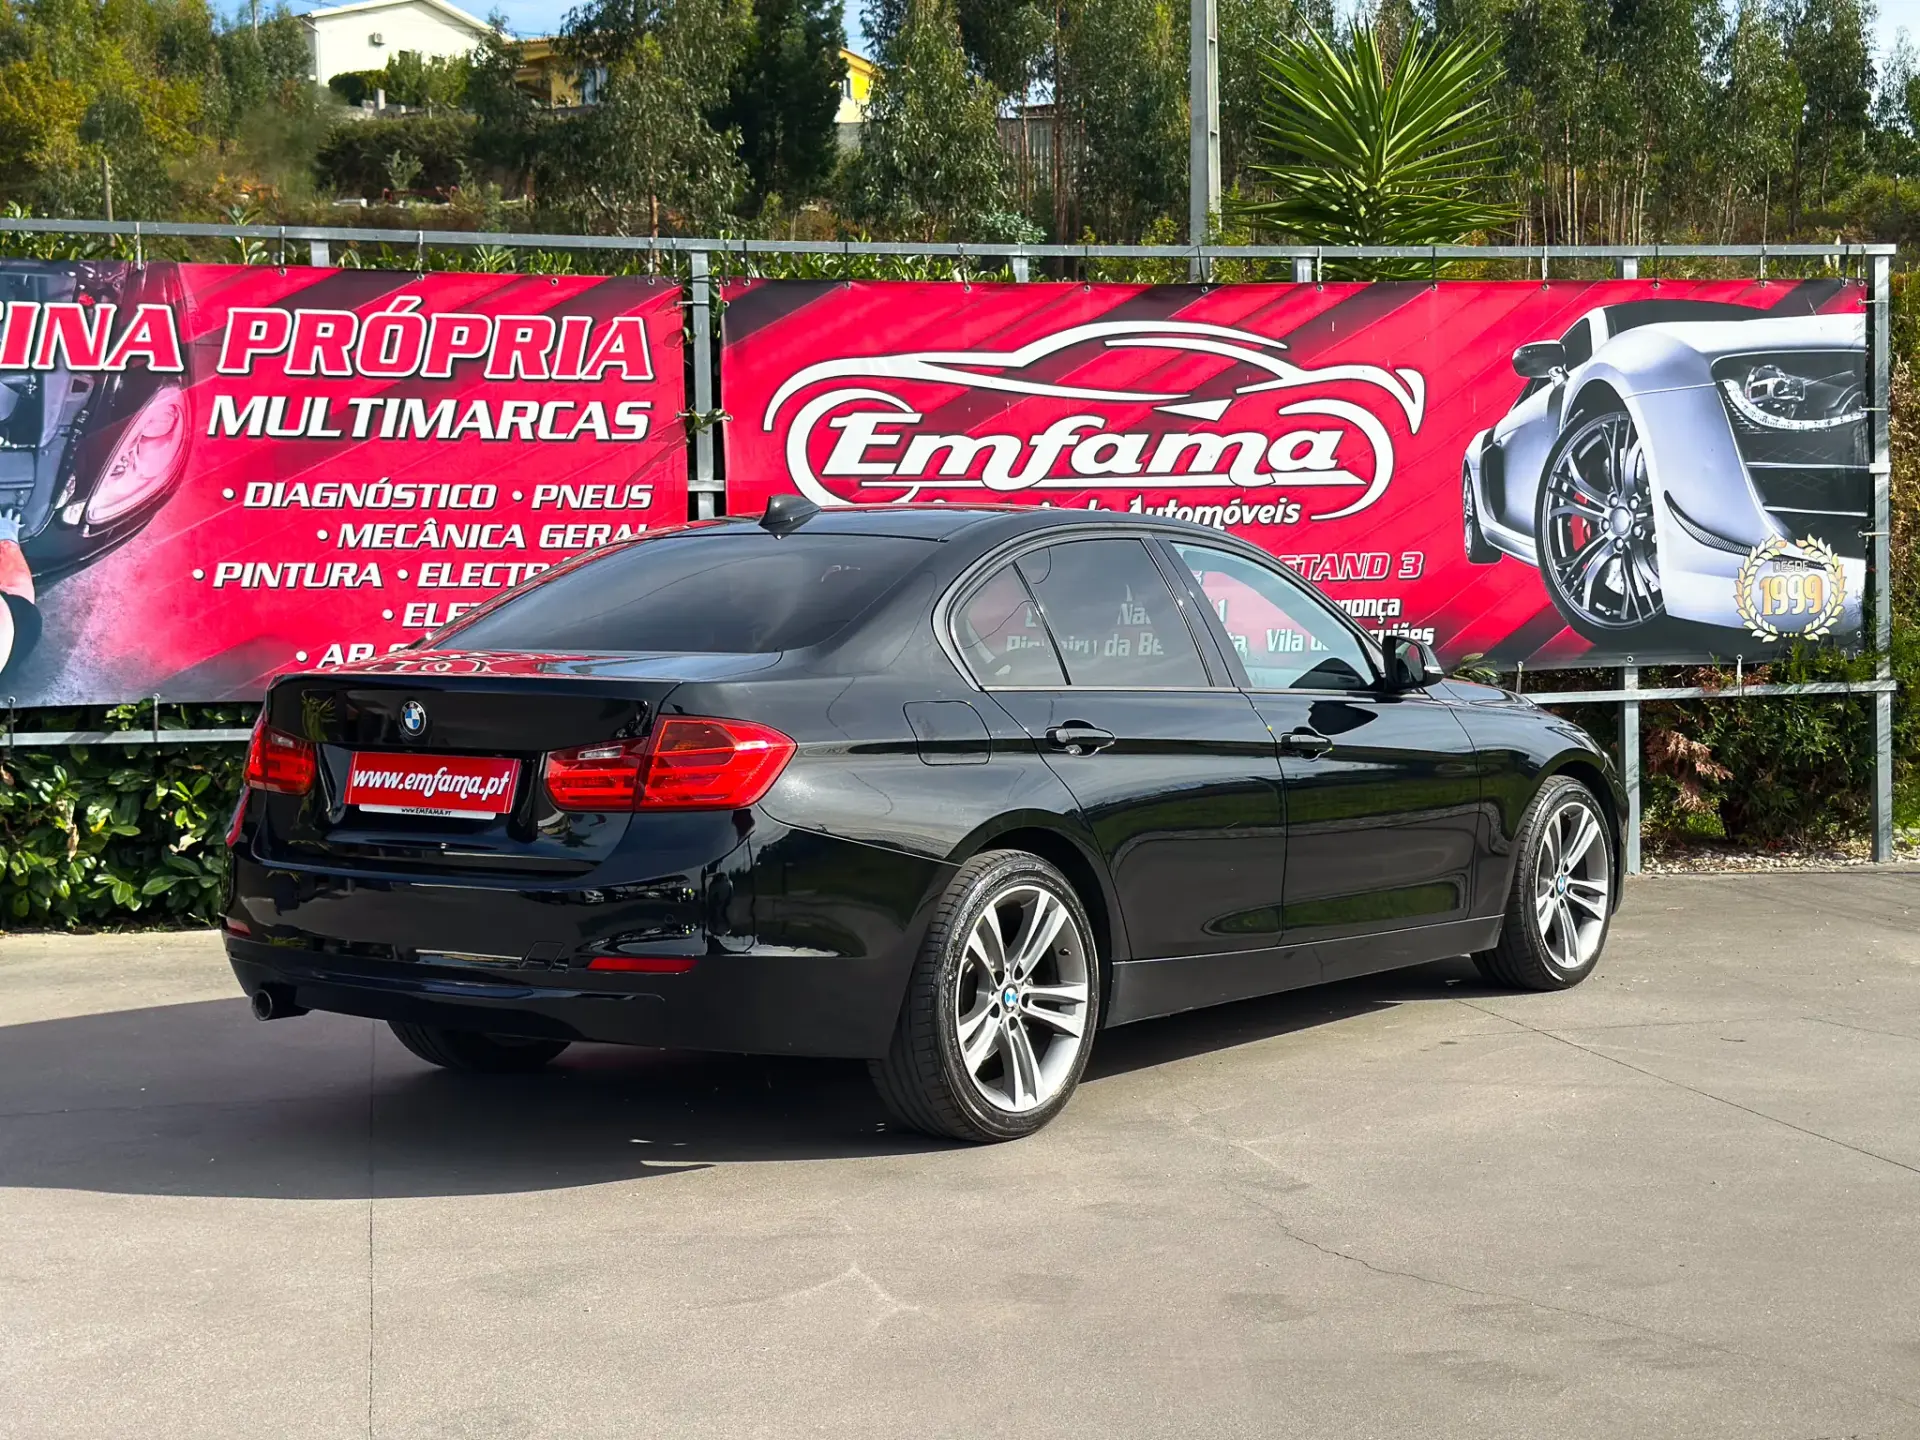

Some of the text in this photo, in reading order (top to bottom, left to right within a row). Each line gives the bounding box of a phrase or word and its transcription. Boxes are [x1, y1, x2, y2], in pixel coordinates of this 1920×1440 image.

[0, 297, 654, 381] INA PRÓPRIA
[207, 396, 652, 440] MULTIMARCAS
[823, 411, 1344, 489] Emfama
[243, 477, 653, 509] DIAGNÓSTICO PNEUS
[337, 519, 526, 549] MECÂNICA
[214, 562, 383, 588] PINTURA
[1399, 551, 1424, 579] 3
[1773, 560, 1810, 573] DESDE
[1759, 574, 1823, 616] 1999
[1104, 633, 1131, 657] da
[1267, 628, 1304, 652] Vila
[353, 766, 510, 801] www.emfama.pt
